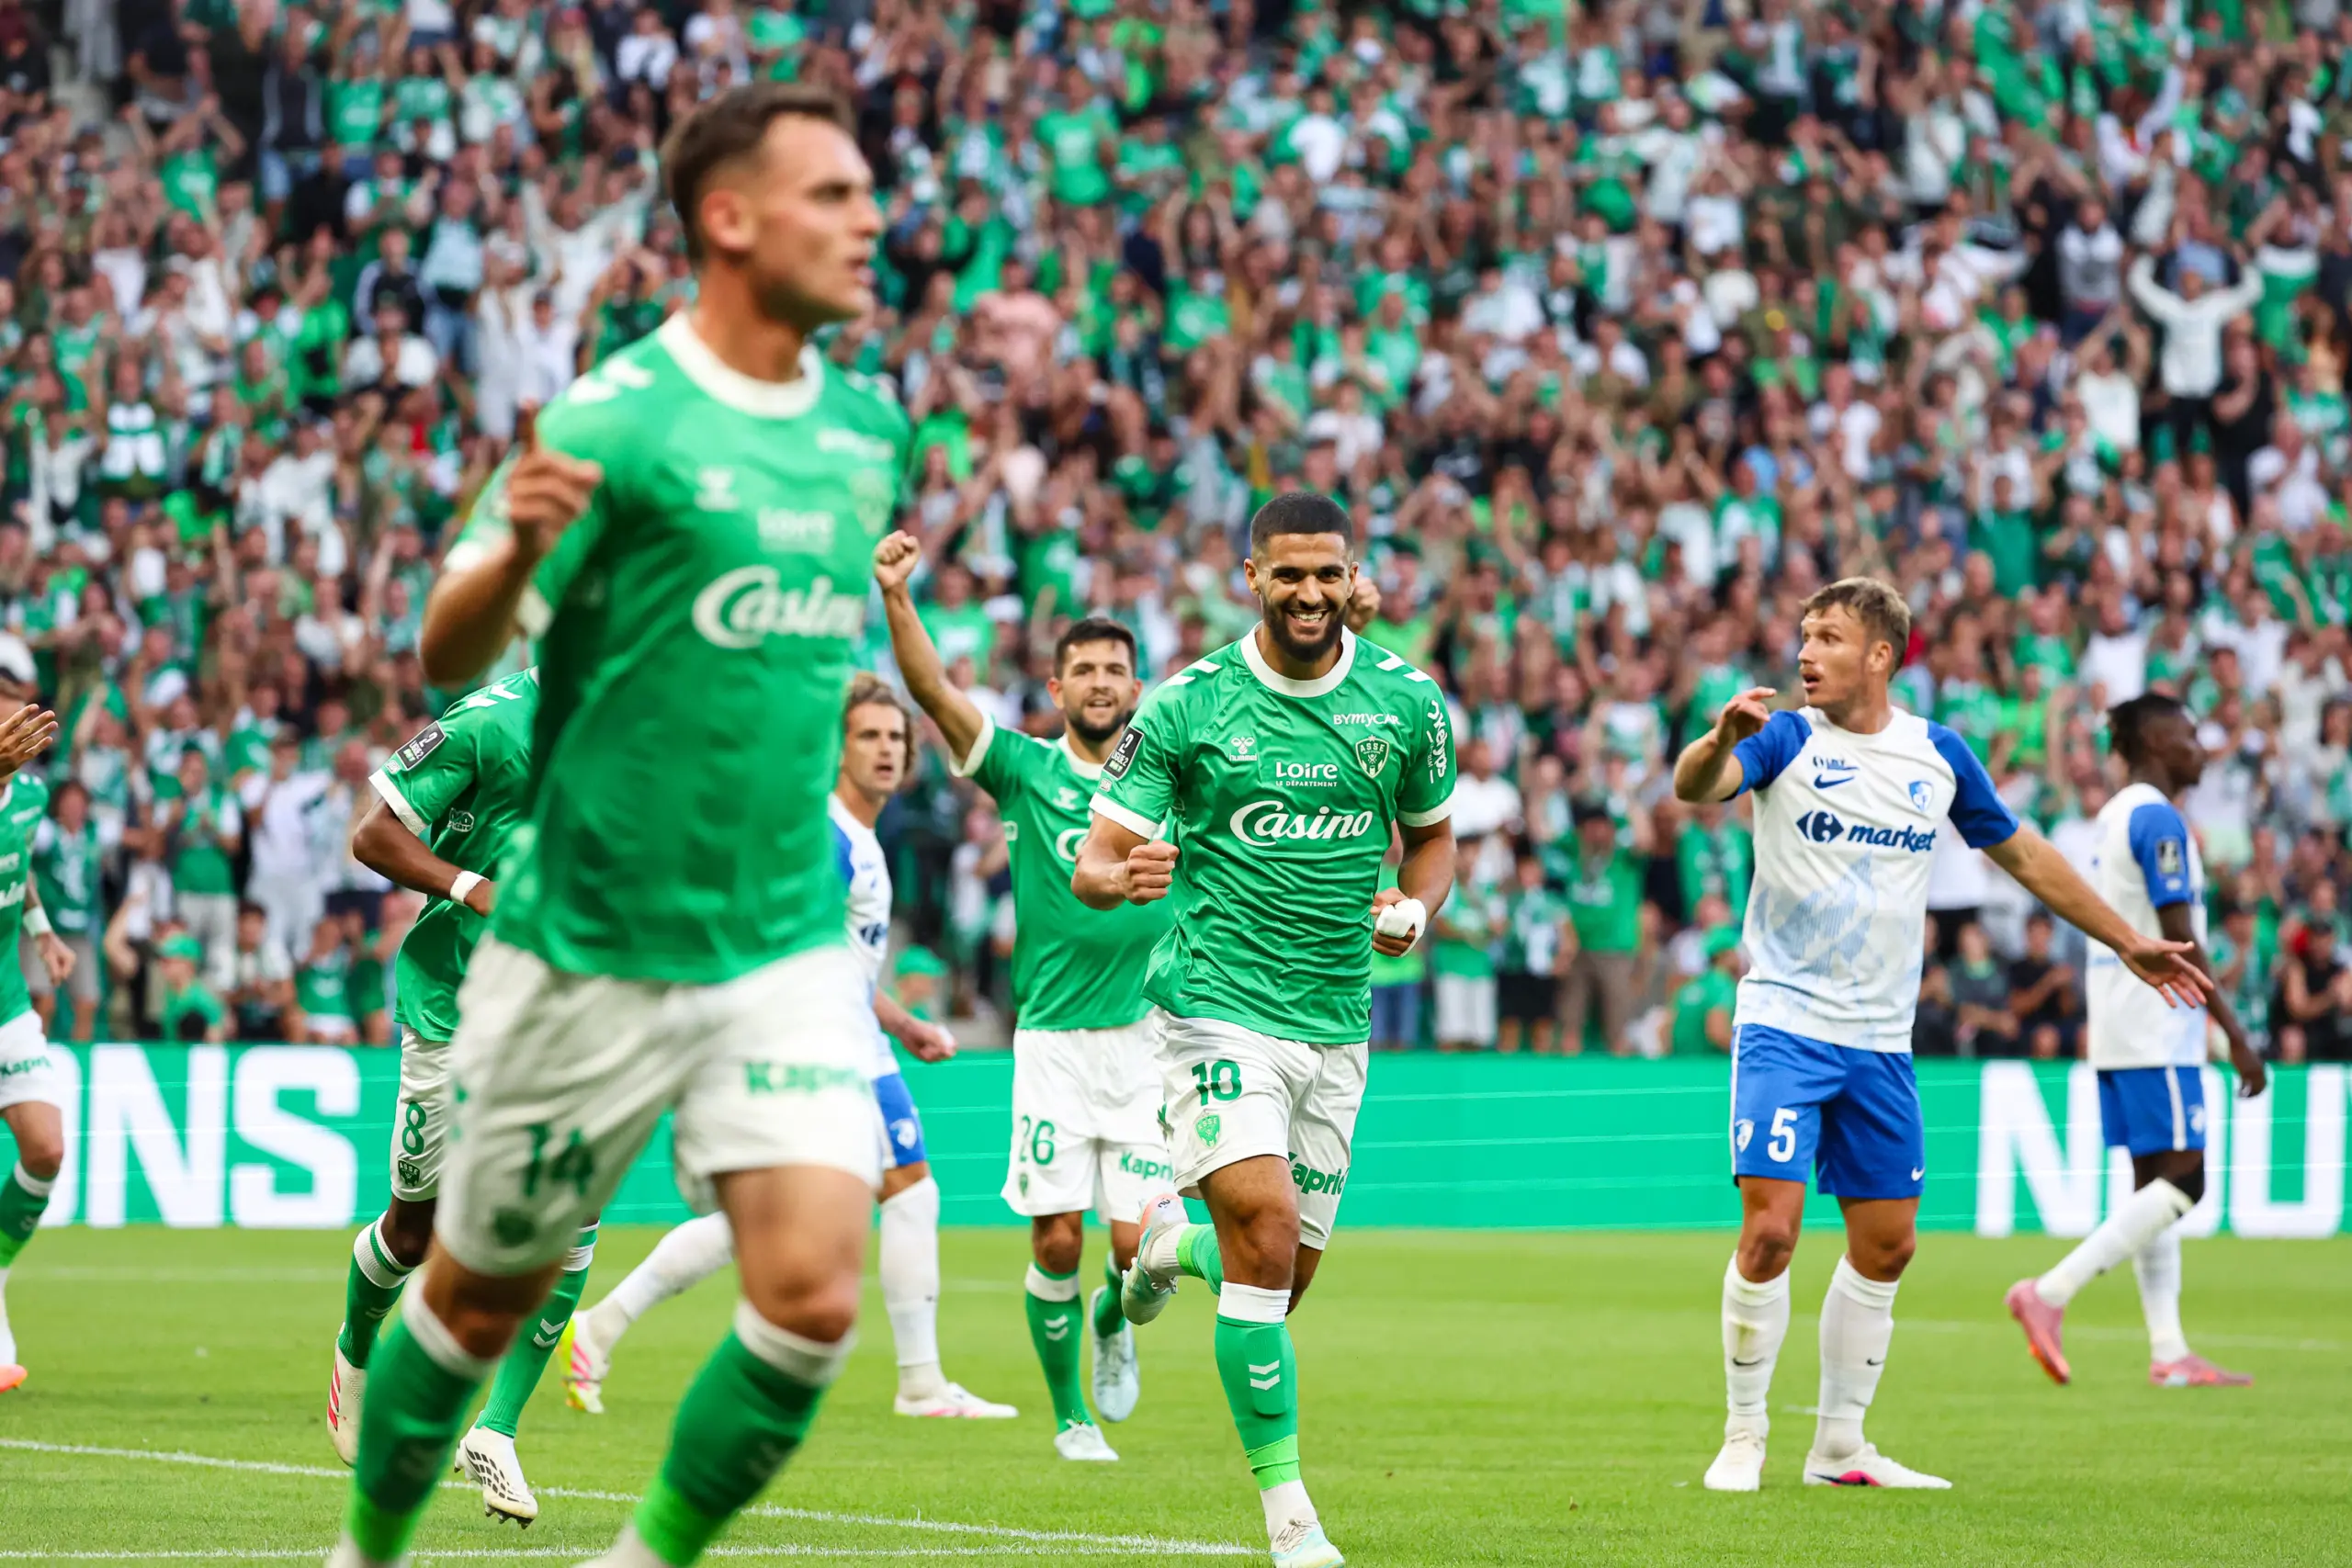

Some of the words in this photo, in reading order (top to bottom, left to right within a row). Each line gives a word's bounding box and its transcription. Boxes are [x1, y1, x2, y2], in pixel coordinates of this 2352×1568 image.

[1118, 733, 1135, 754] 2
[1360, 742, 1385, 753] ASSE
[1275, 761, 1339, 780] Loire
[1229, 800, 1374, 847] Casino
[1847, 824, 1937, 852] market
[401, 1100, 426, 1156] 8
[1019, 1114, 1055, 1166] 26
[1768, 1107, 1798, 1163] 5
